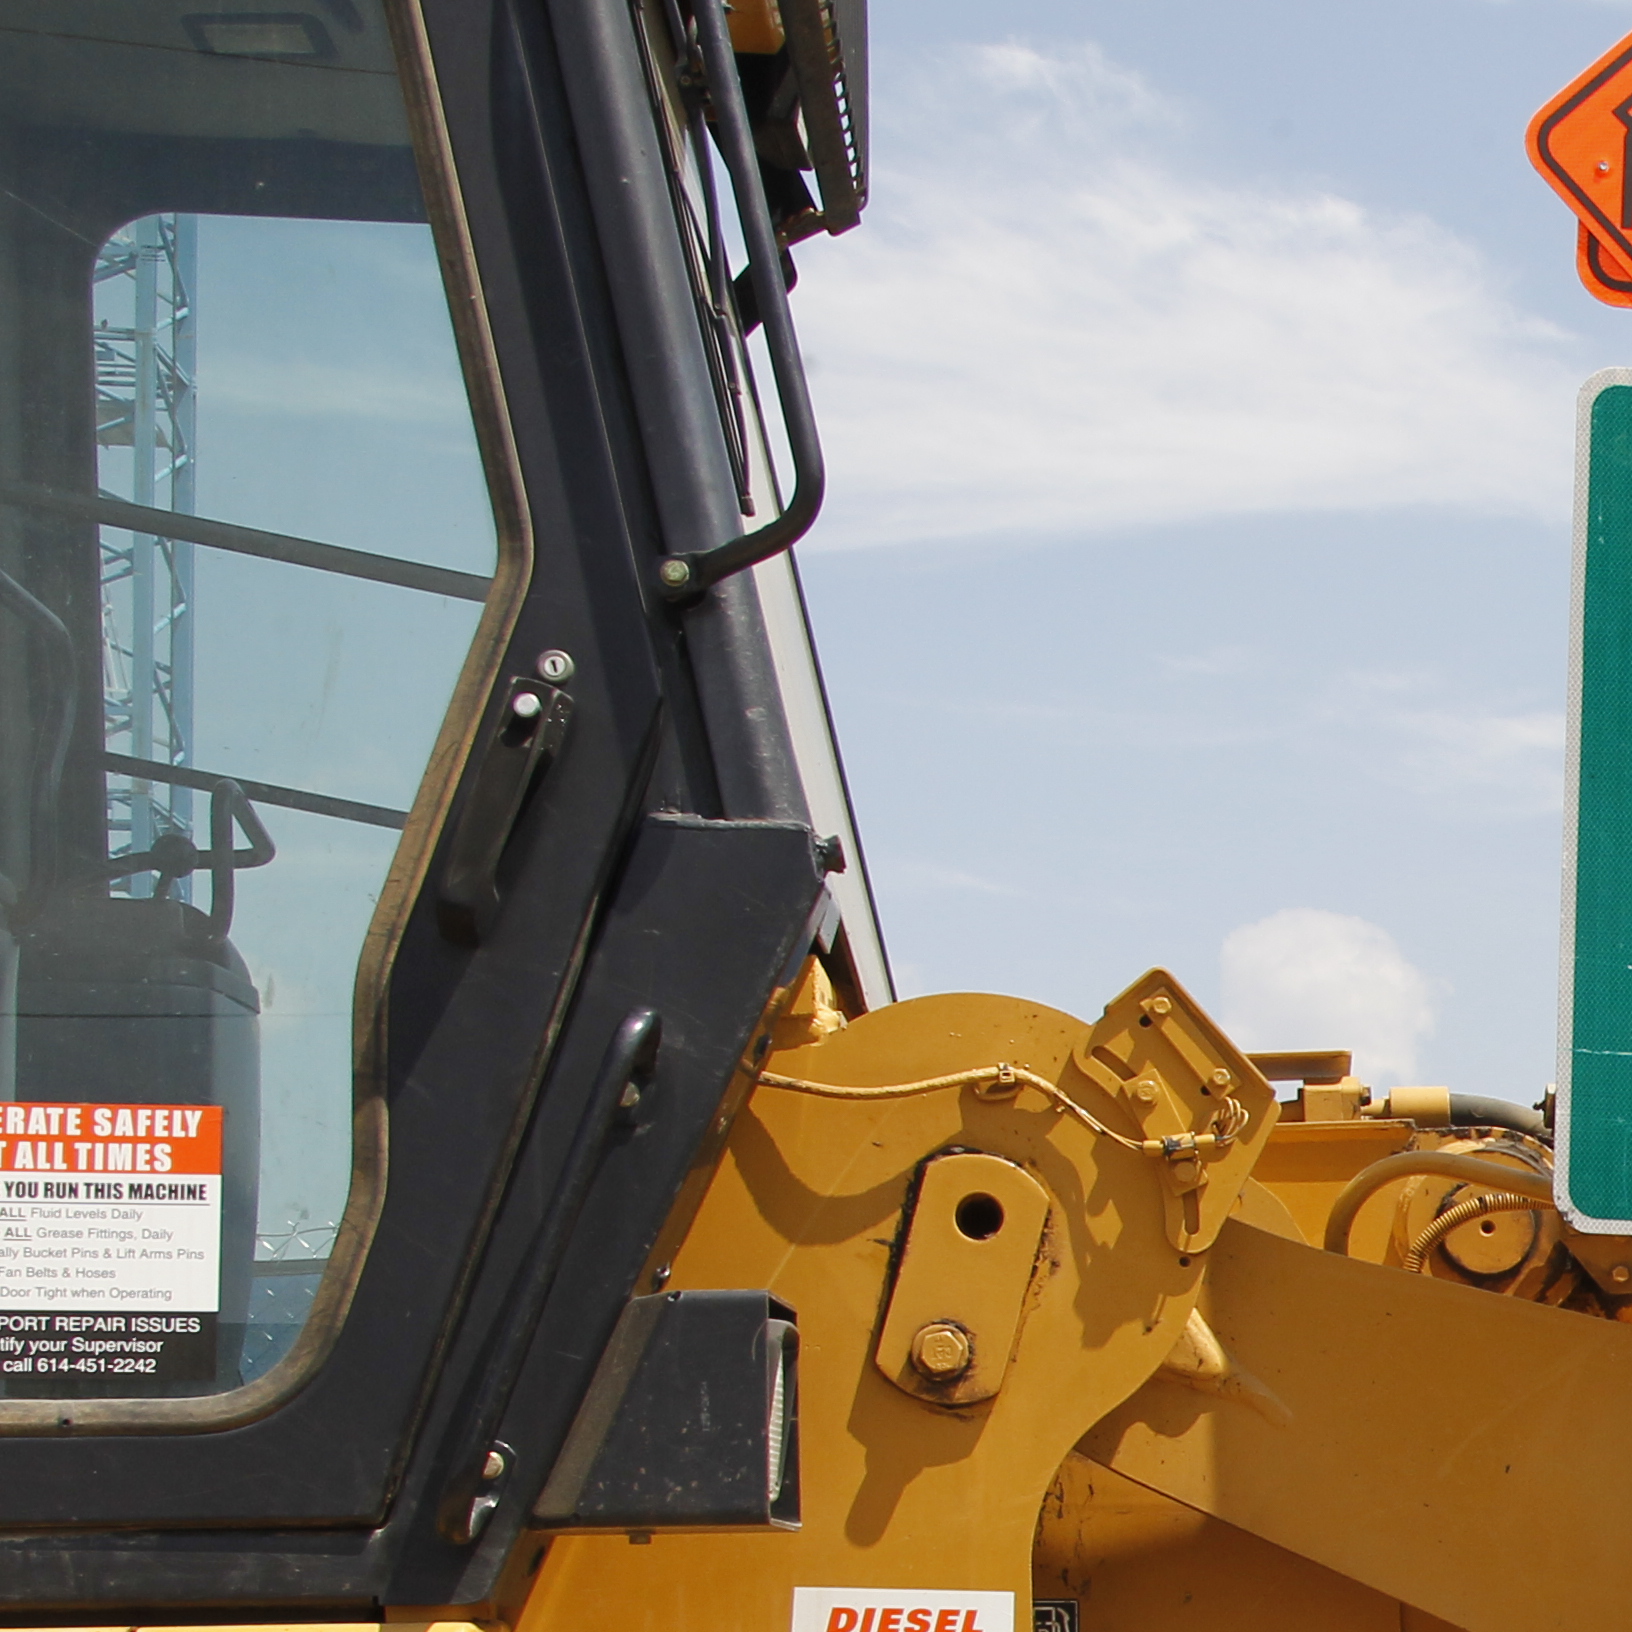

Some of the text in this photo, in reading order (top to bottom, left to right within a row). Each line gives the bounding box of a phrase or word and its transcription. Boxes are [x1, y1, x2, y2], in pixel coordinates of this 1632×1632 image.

[0, 1106, 204, 1138] RATE SAFELY
[13, 1140, 68, 1170] ALL
[73, 1142, 173, 1172] TIMES
[4, 1181, 208, 1201] YOU RUN THIS MACHINE
[0, 1207, 144, 1222] ALL Fluid Levels Daily
[4, 1227, 33, 1238] ALL
[36, 1227, 84, 1239] Grease
[141, 1229, 174, 1242] Daily
[23, 1247, 68, 1259] Bucket
[71, 1247, 99, 1259] Pins
[103, 1248, 113, 1260] &
[116, 1248, 136, 1260] Lift
[139, 1249, 174, 1260] Arms
[177, 1249, 206, 1261] Pins
[26, 1267, 58, 1279] Belts
[62, 1268, 72, 1279] &
[75, 1268, 117, 1280] Hoses
[0, 1286, 173, 1302] Door Tight when Operating
[55, 1317, 126, 1333] REPAIR
[131, 1317, 201, 1333] ISSUES
[29, 1341, 68, 1356] your
[71, 1337, 164, 1355] Supervisor
[3, 1358, 157, 1374] call 614-451-2242
